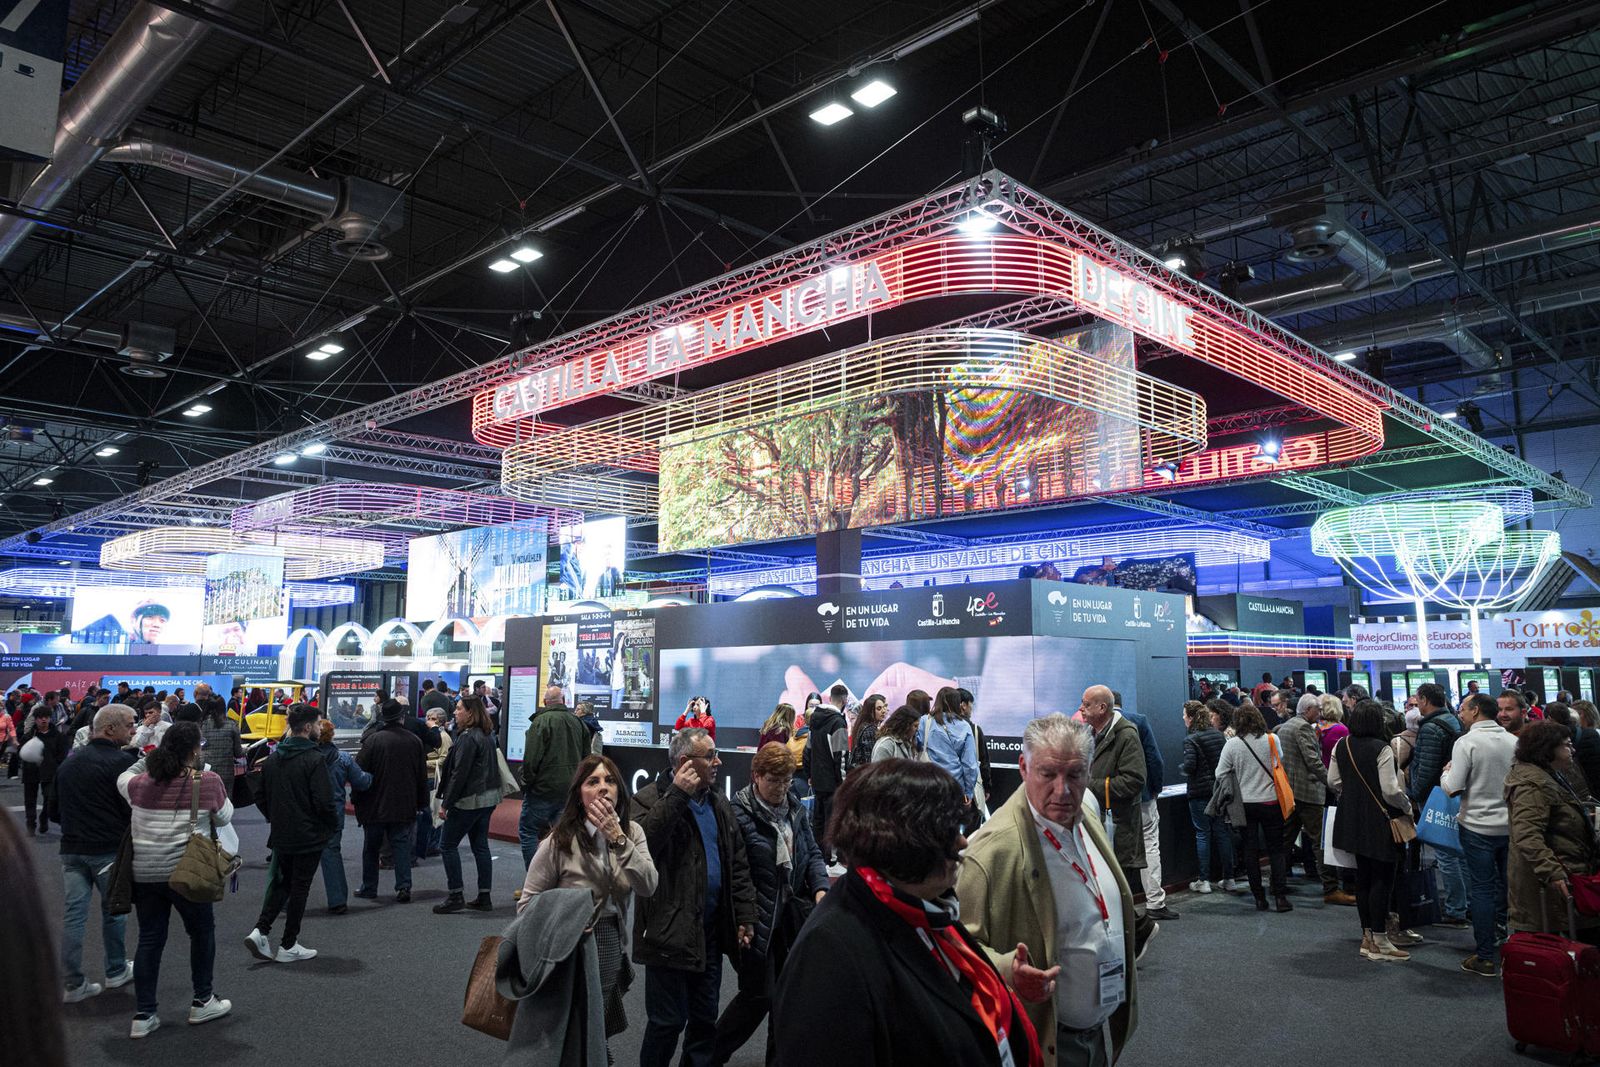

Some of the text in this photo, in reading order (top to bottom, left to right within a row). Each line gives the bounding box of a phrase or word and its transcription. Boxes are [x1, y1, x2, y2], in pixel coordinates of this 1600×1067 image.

[1078, 254, 1124, 315] DE
[493, 349, 622, 419] CASTILLA
[646, 327, 690, 372] LA
[703, 260, 892, 357] MANCHA
[758, 541, 1080, 585] CASTILLA ANCHA UN VIAJE DE CINE
[846, 603, 899, 616] EN UN LUGAR
[1072, 599, 1112, 611] EN UN LUGAR
[846, 618, 890, 629] DE TU VIDA
[1072, 613, 1107, 624] DE TU VIDA
[1356, 631, 1472, 644] #MejorClimaeEuropa
[1496, 639, 1527, 651] mejor
[1564, 639, 1579, 649] de
[235, 658, 278, 666] CULINARIA
[986, 739, 1023, 751] cine.co
